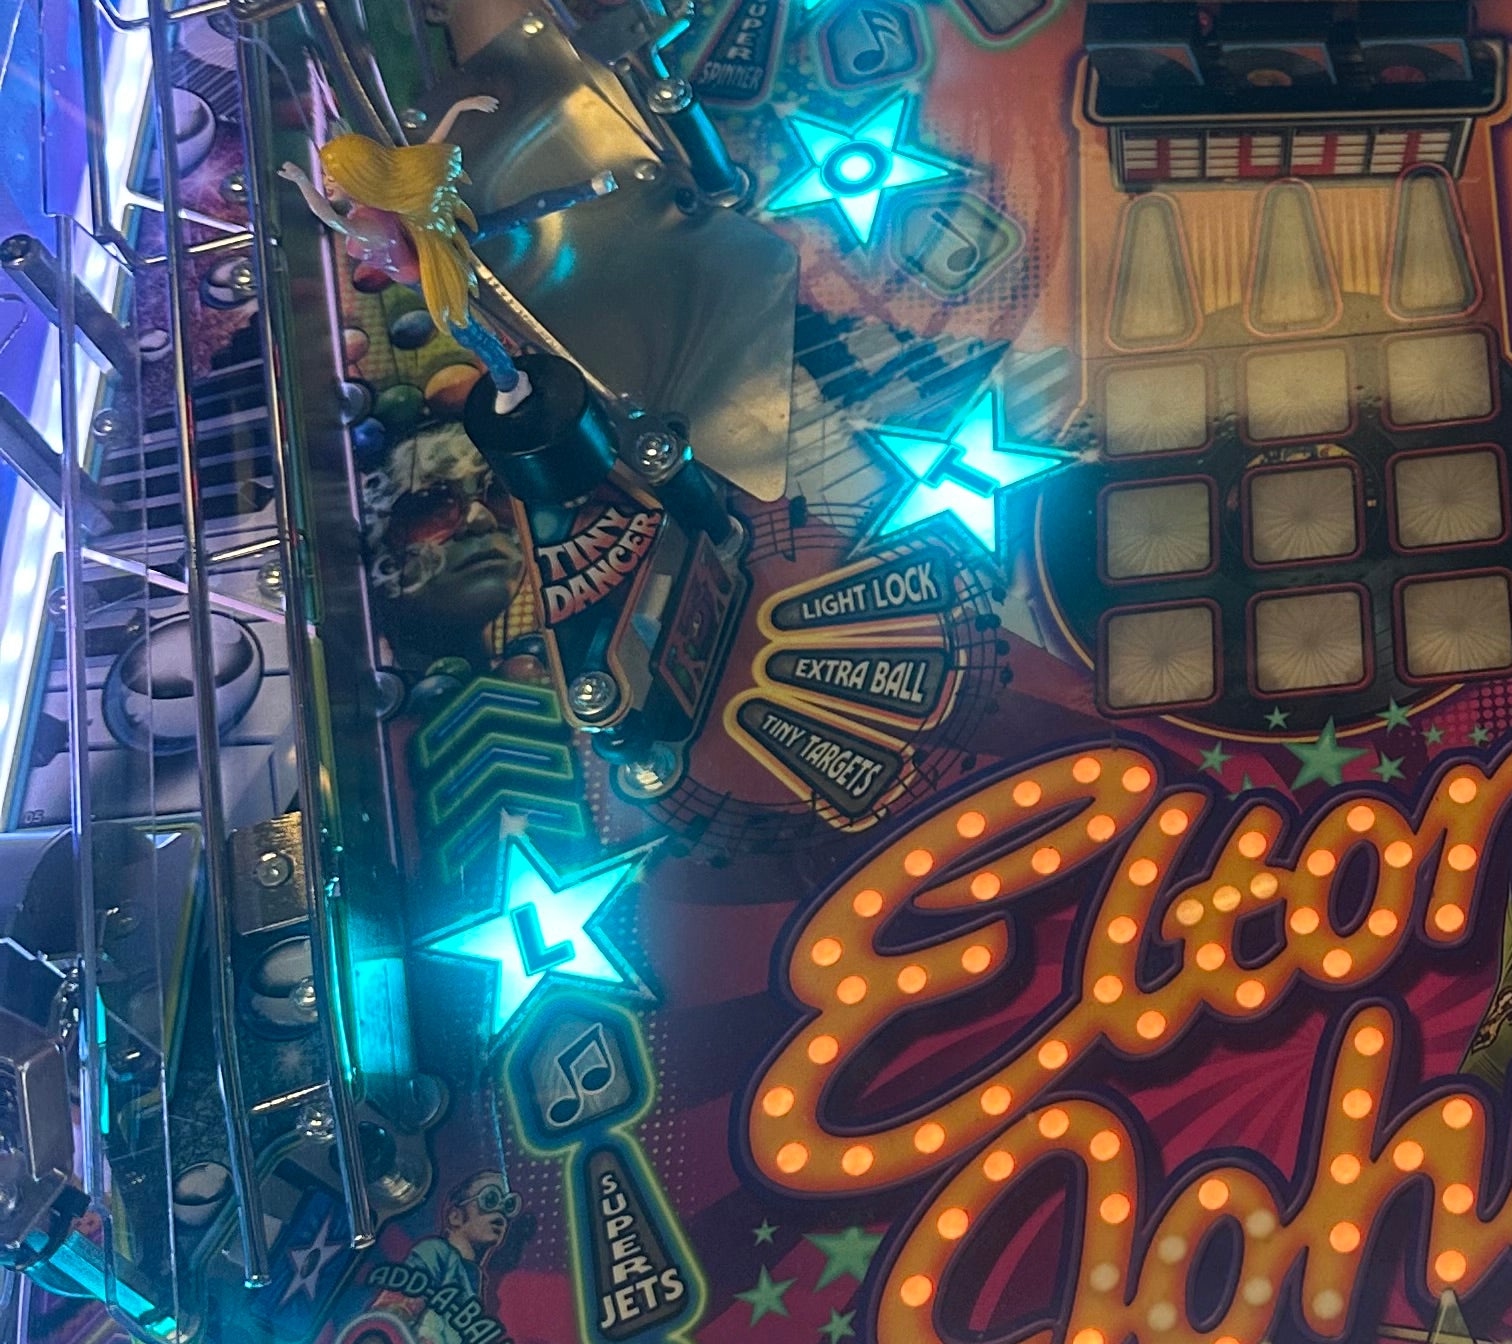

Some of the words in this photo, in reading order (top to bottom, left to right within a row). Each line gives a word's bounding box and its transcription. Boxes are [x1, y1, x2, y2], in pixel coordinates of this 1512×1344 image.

[701, 61, 765, 90] SPINNER
[538, 506, 623, 581] TINY
[544, 510, 661, 626] DANCER
[801, 586, 867, 621] LIGHT
[870, 562, 938, 610] LOCK
[795, 657, 869, 690] EXTRA
[873, 660, 927, 705] BALL
[761, 711, 801, 749] TINY
[801, 734, 883, 798] TARGETS
[510, 902, 575, 975] L
[600, 1171, 653, 1284] SUPER
[600, 1268, 685, 1330] JETS
